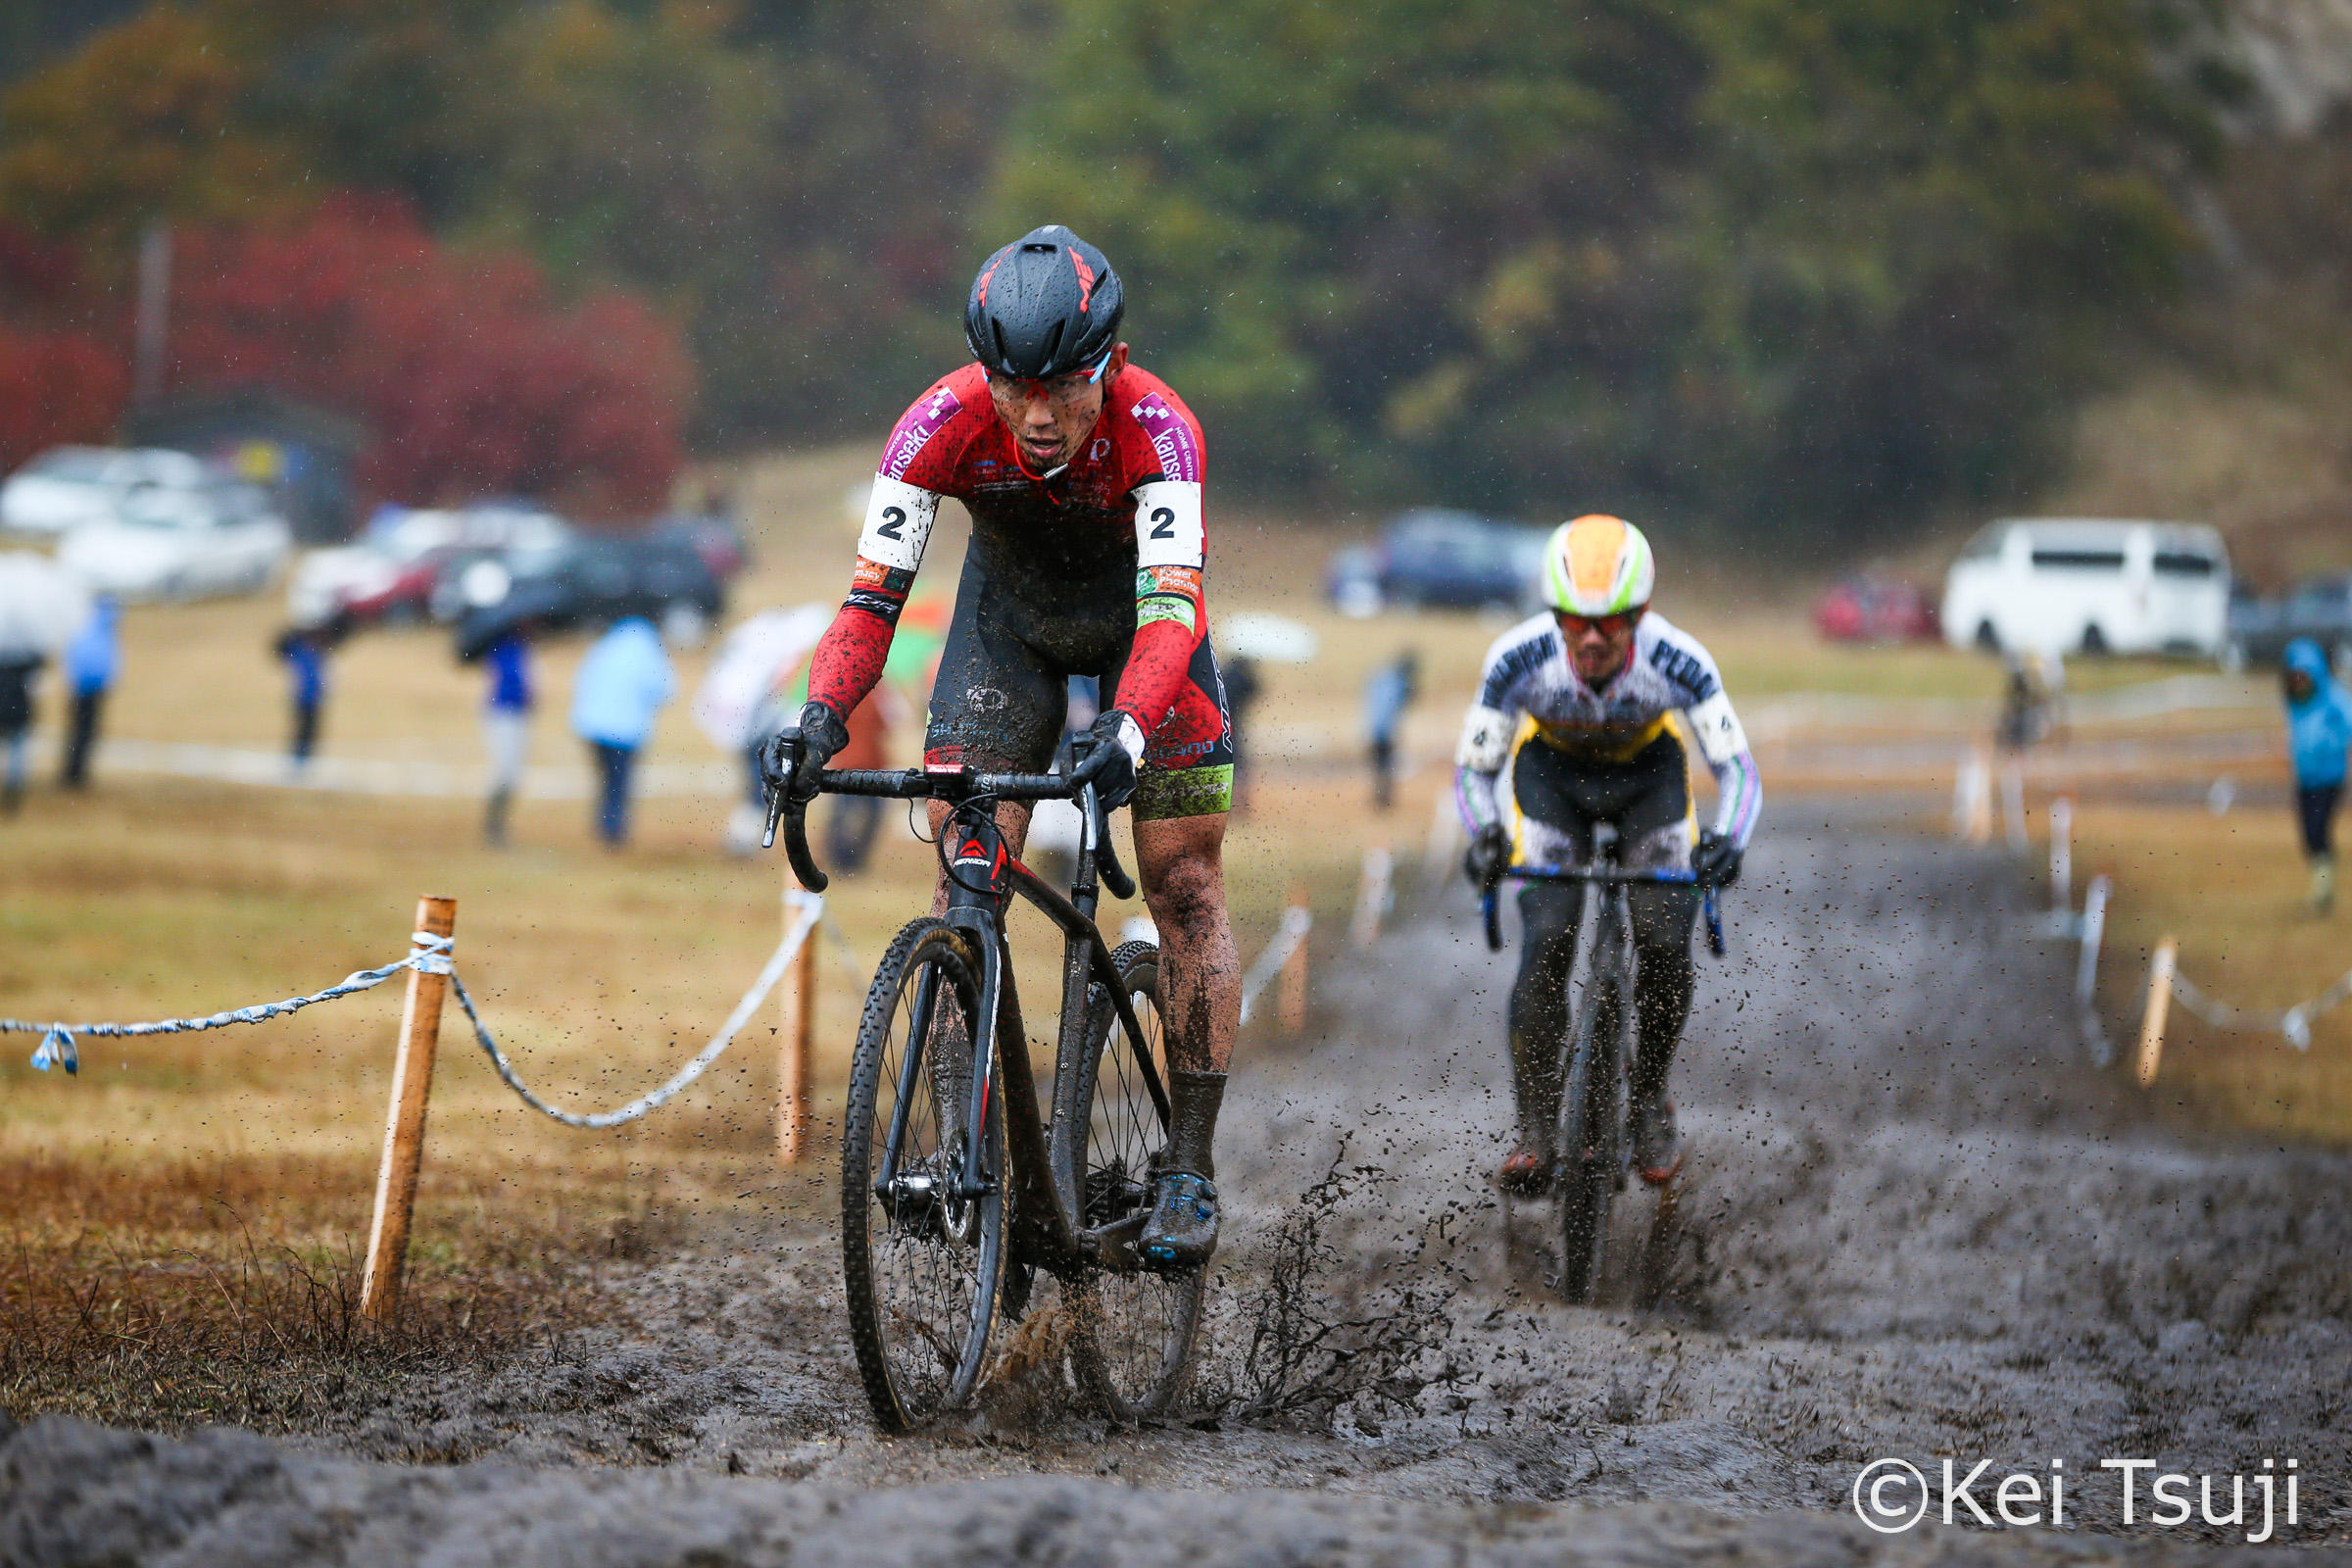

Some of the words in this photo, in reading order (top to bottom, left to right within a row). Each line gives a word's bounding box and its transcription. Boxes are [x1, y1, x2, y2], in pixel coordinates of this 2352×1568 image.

[887, 420, 931, 480] anseki
[1152, 427, 1182, 481] kanse
[1174, 426, 1190, 450] HOME
[877, 507, 906, 540] 2
[1150, 507, 1175, 539] 2
[1159, 568, 1192, 578] Power
